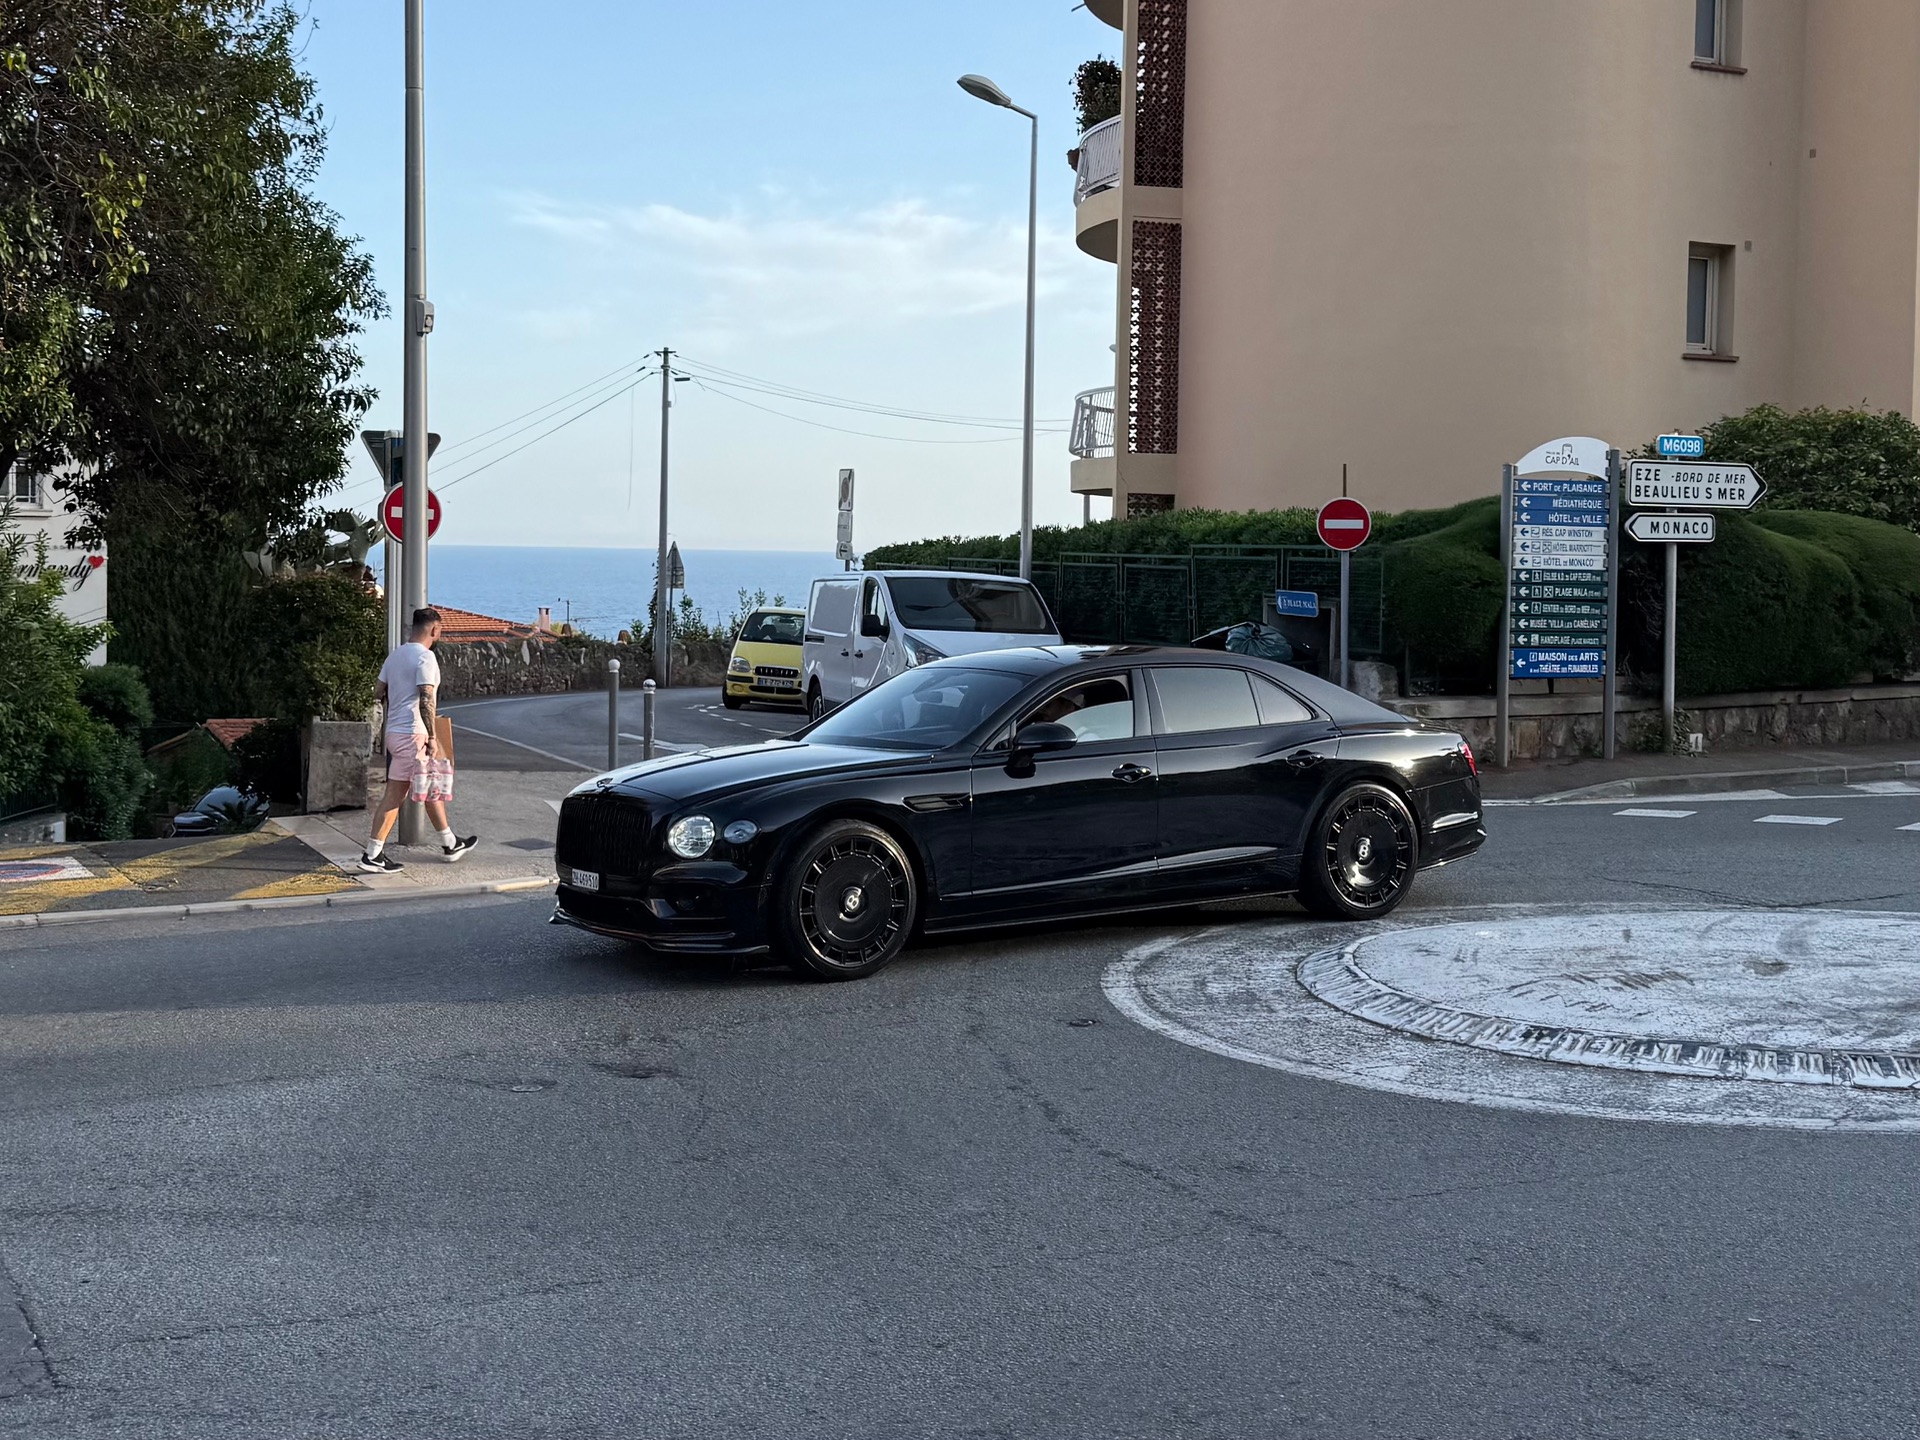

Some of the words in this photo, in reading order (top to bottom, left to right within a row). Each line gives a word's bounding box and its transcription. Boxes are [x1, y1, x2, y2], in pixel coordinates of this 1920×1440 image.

[1663, 439, 1701, 453] M6098
[1545, 455, 1560, 464] CAP
[1636, 468, 1661, 481] EZE
[1707, 473, 1721, 484] DE
[1724, 474, 1746, 484] MER
[1533, 482, 1553, 491] PORT
[1562, 483, 1603, 493] PLAISANCE
[1635, 485, 1700, 499] BEAULIEU
[1705, 487, 1713, 500] S
[1718, 488, 1745, 500] MER
[1552, 498, 1602, 509] MÉDIATHÈQUE
[1548, 512, 1572, 523] HÔTEL
[1582, 514, 1602, 524] VILLE
[1650, 521, 1709, 534] MONACO
[1538, 652, 1567, 661] MAISON
[1579, 652, 1599, 661] ARTS
